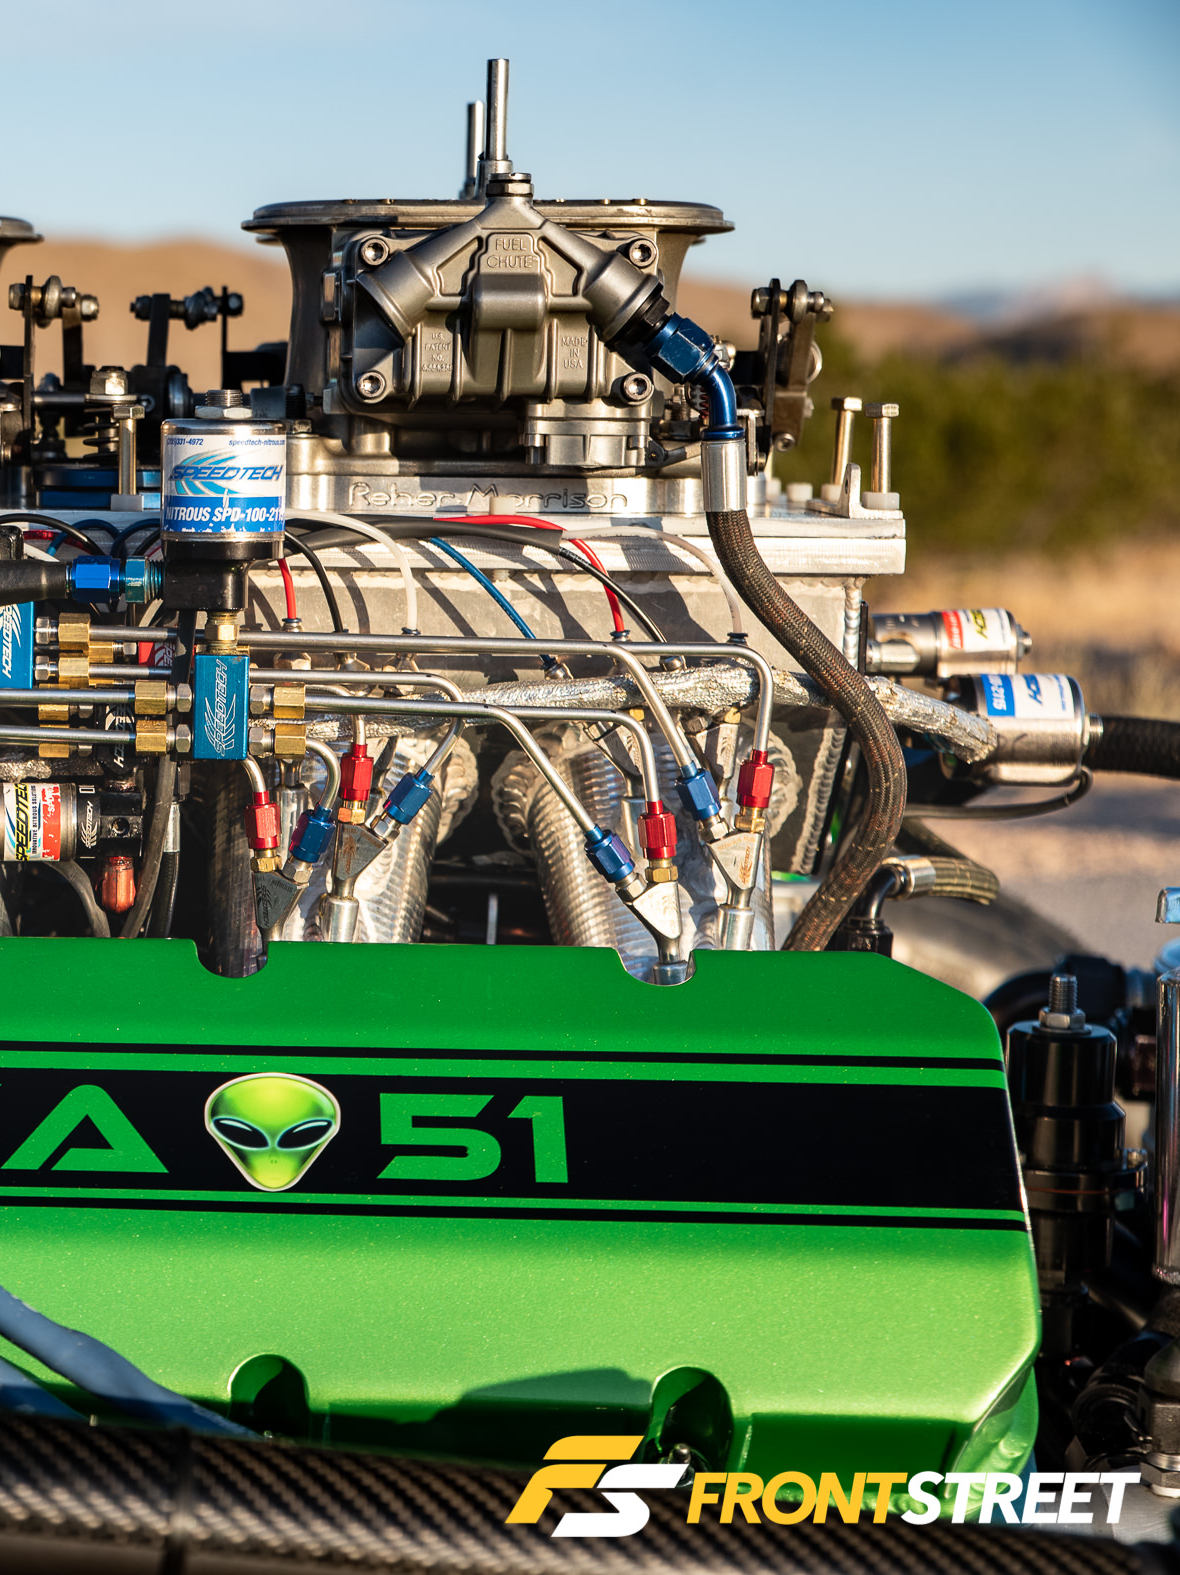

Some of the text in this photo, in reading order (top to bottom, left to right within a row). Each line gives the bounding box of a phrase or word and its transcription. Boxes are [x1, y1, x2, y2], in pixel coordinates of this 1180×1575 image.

[495, 238, 527, 251] FUEL
[561, 336, 587, 348] MADE
[569, 348, 580, 358] IN
[563, 358, 584, 370] USA
[168, 465, 284, 481] SPEEDTECH
[166, 507, 211, 521] NITROUS
[214, 658, 228, 757] SPEEDTECH
[15, 783, 30, 861] SPEEDTEC
[376, 1092, 569, 1184] 51
